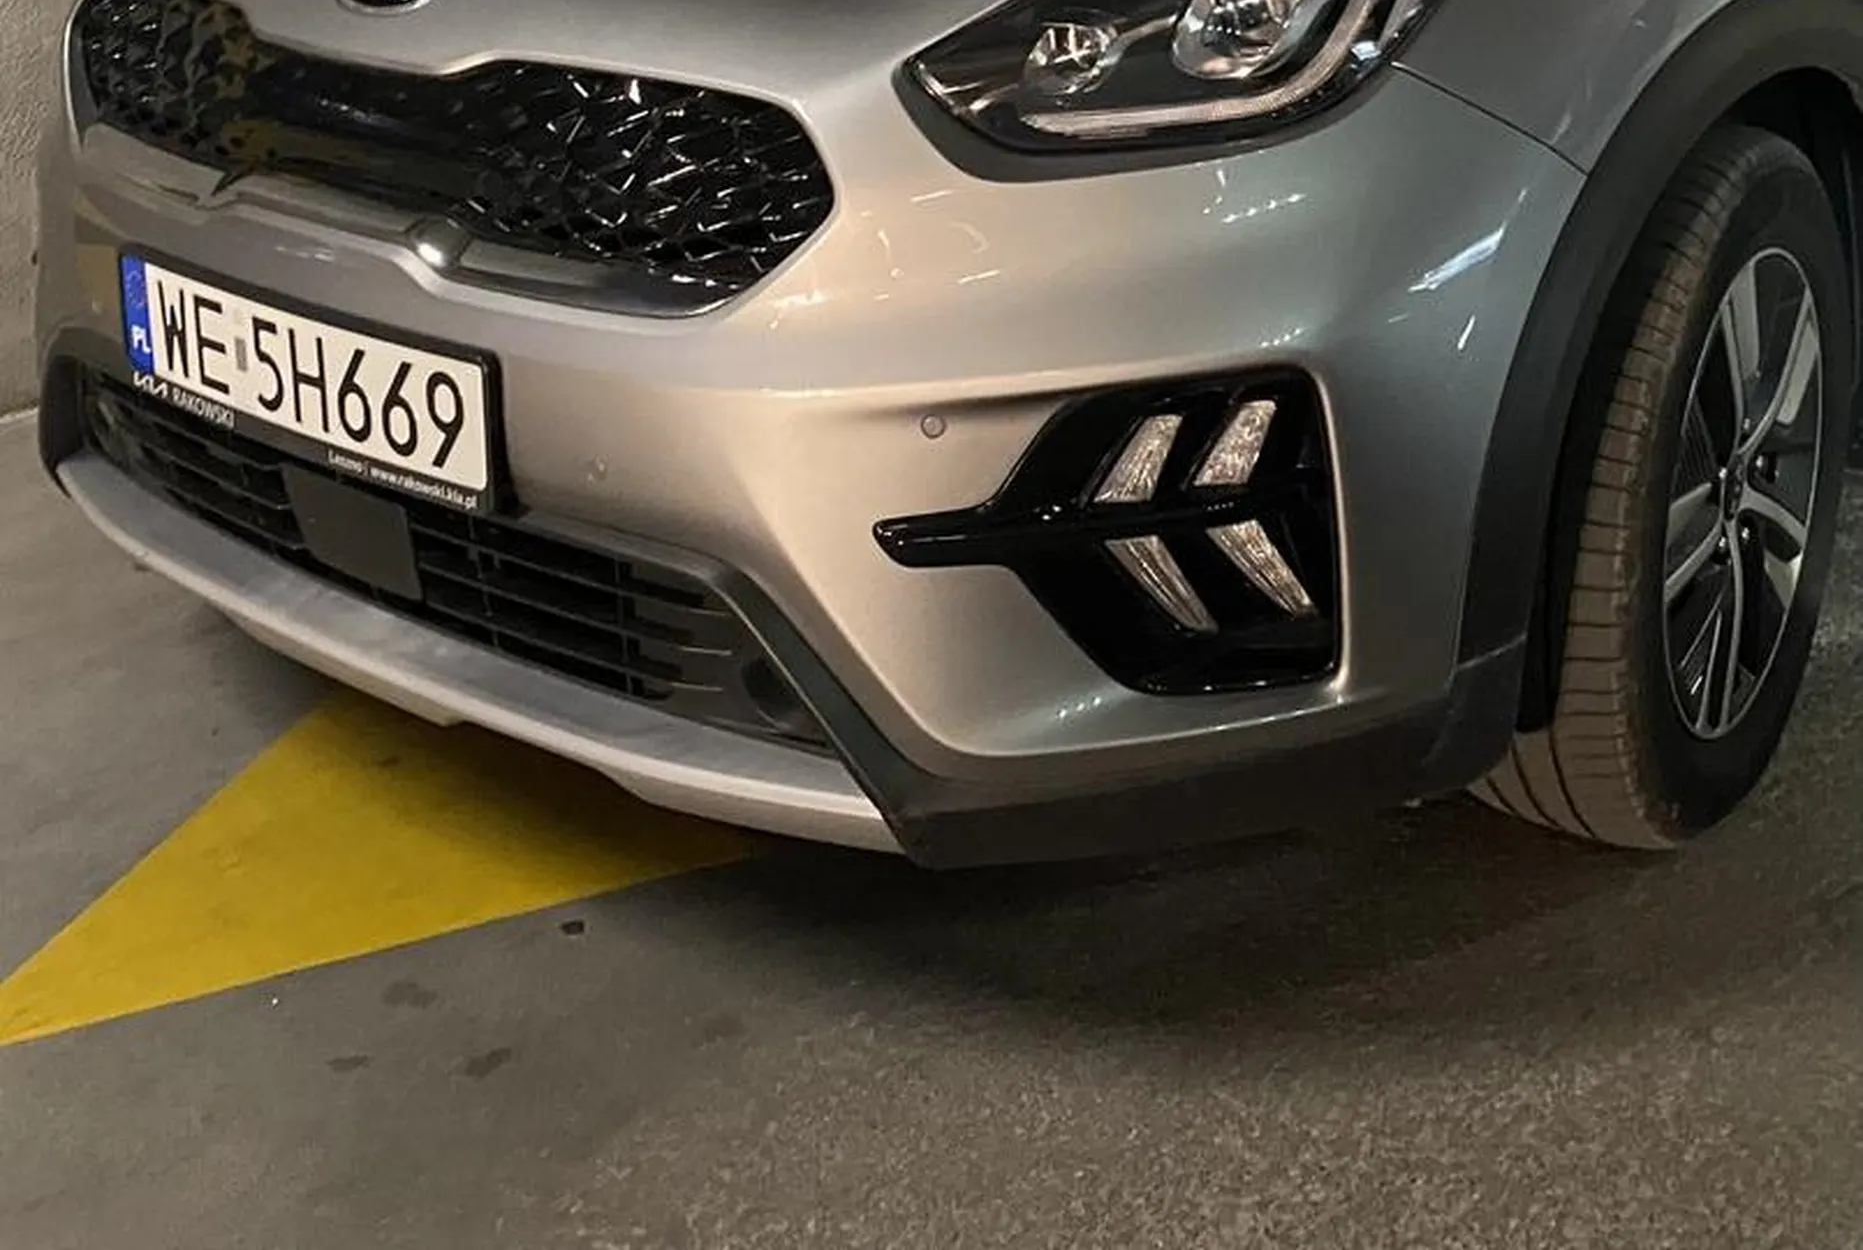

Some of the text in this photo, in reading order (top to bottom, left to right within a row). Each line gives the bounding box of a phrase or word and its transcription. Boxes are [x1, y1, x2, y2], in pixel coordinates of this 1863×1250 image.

[131, 323, 151, 354] PL
[157, 280, 465, 469] WE 5H669
[171, 387, 236, 430] RAKOWSKI
